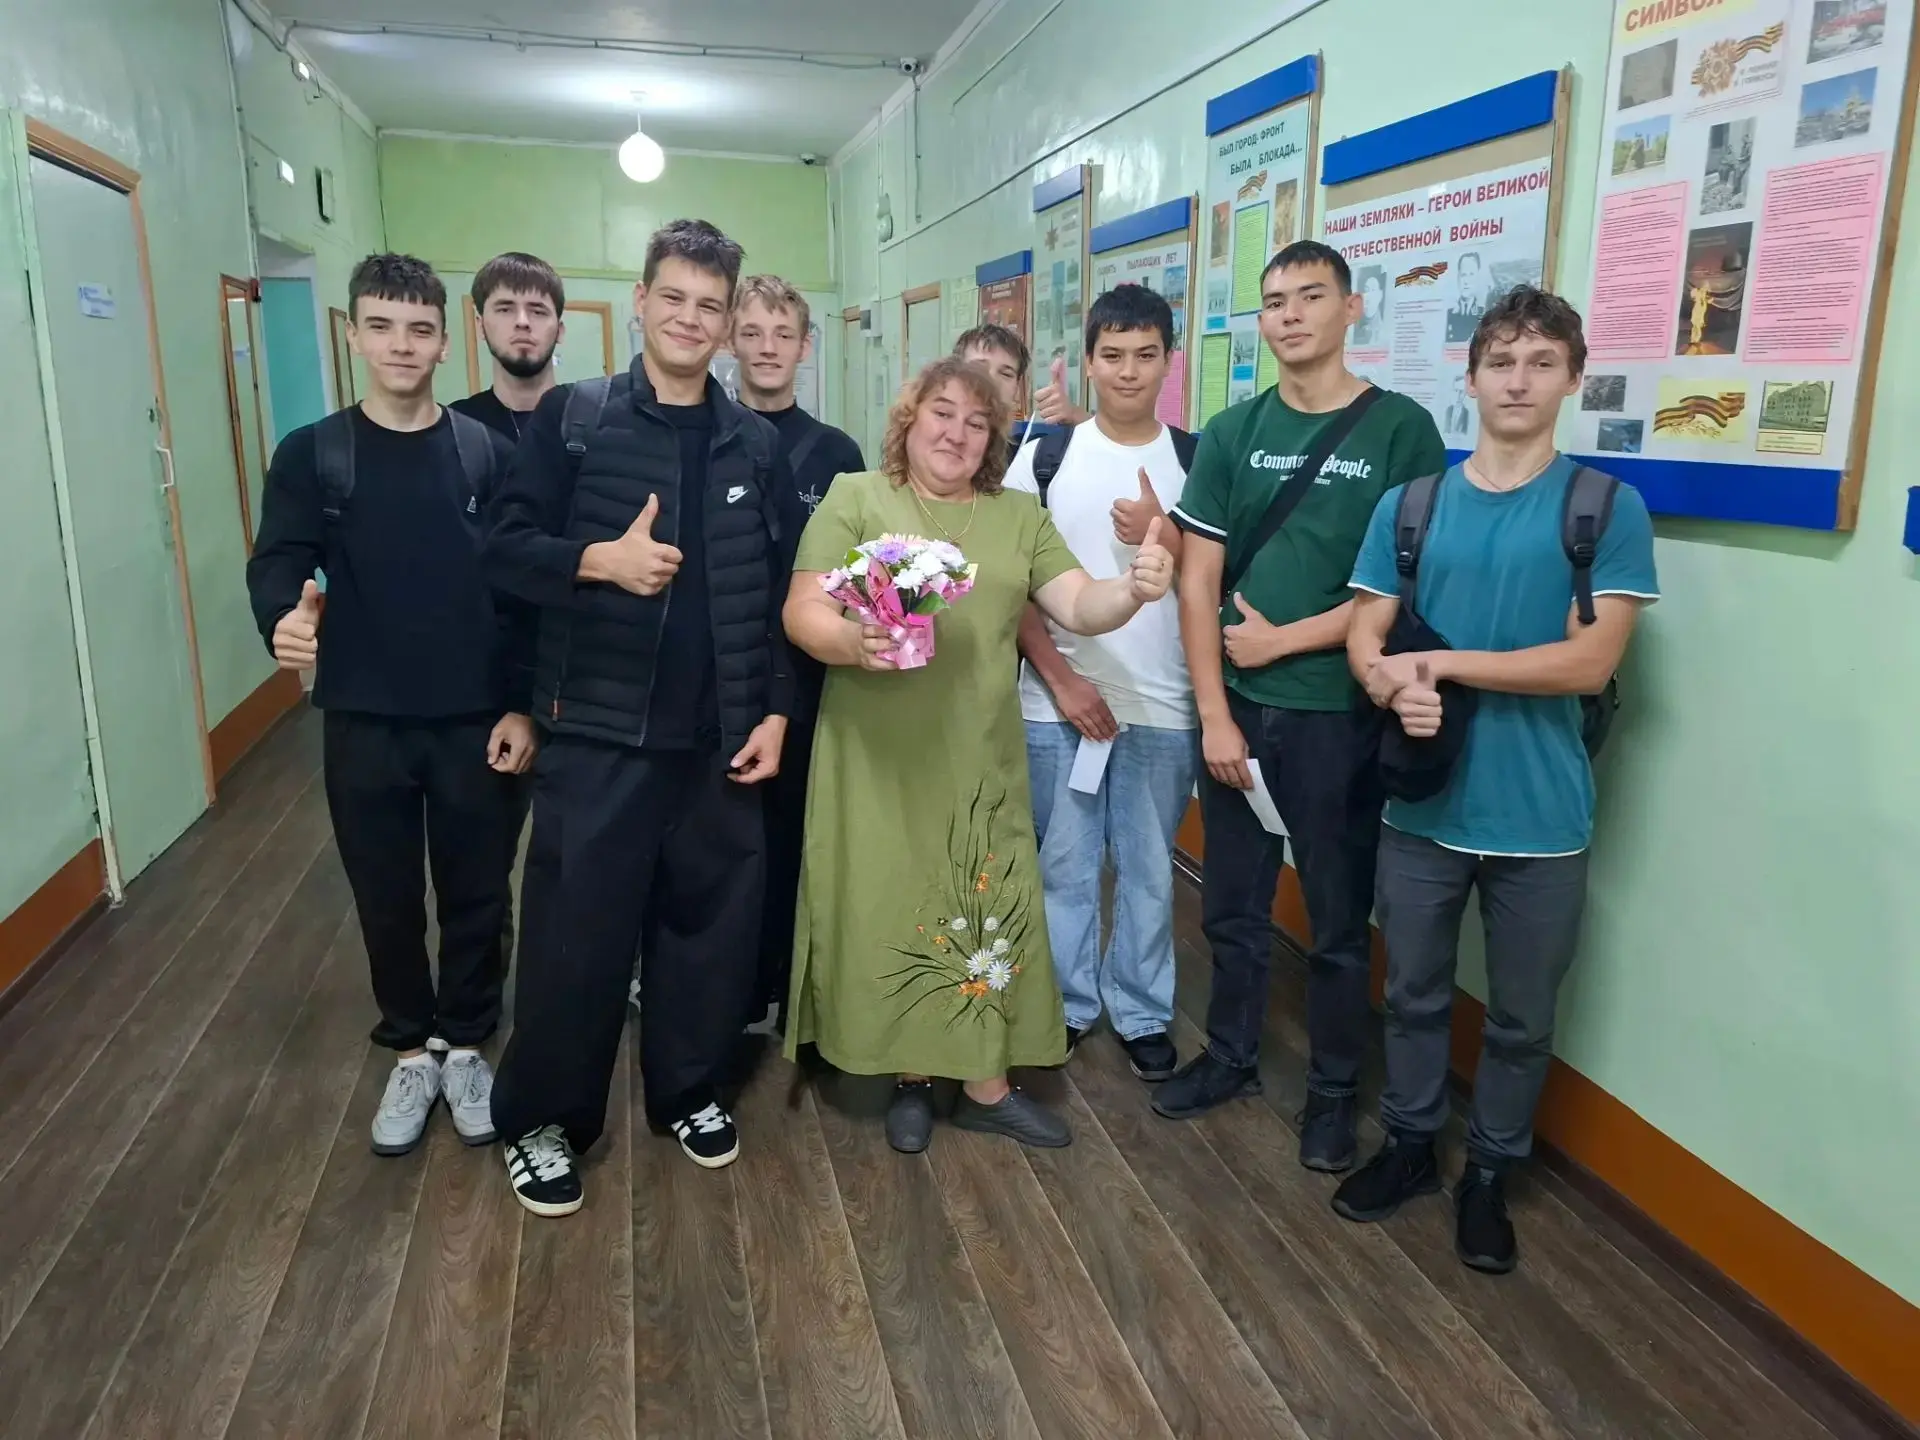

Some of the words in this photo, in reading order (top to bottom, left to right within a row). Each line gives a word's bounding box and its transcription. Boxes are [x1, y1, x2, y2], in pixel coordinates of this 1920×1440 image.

[1625, 0, 1723, 32] СИМВО
[1219, 143, 1234, 157] БЫЛ
[1260, 121, 1285, 140] ФРОНТ
[1230, 158, 1252, 175] БЫЛА
[1325, 215, 1357, 235] НАШИ
[1359, 203, 1414, 228] ЗЕМЛЯКИ
[1427, 189, 1472, 213] ГЕРОИ
[1476, 166, 1550, 202] ВЕЛИКОЙ
[1341, 225, 1441, 261] ОТЕЧЕСТВЕННОЙ
[1449, 217, 1504, 242] ВОЙНЫ
[1249, 449, 1309, 470] Commo
[1319, 453, 1372, 480] People
